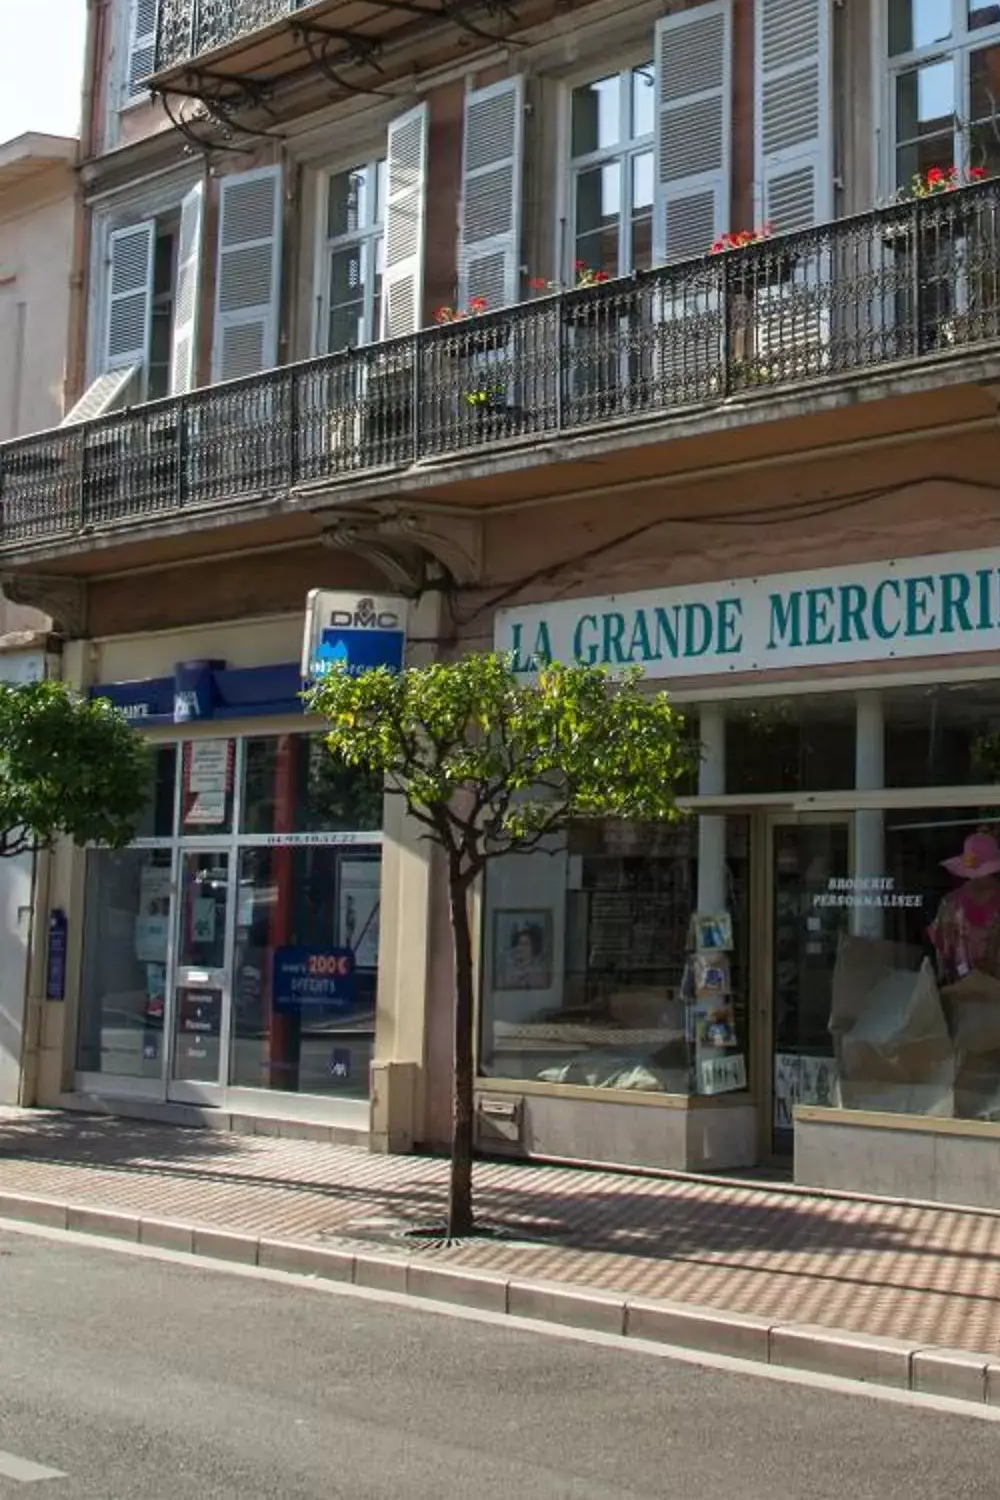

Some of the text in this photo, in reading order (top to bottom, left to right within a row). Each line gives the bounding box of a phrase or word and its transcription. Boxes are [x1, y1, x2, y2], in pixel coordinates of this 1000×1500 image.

[331, 611, 398, 628] DMC
[511, 620, 551, 673] LA
[573, 598, 743, 666] GRANDE
